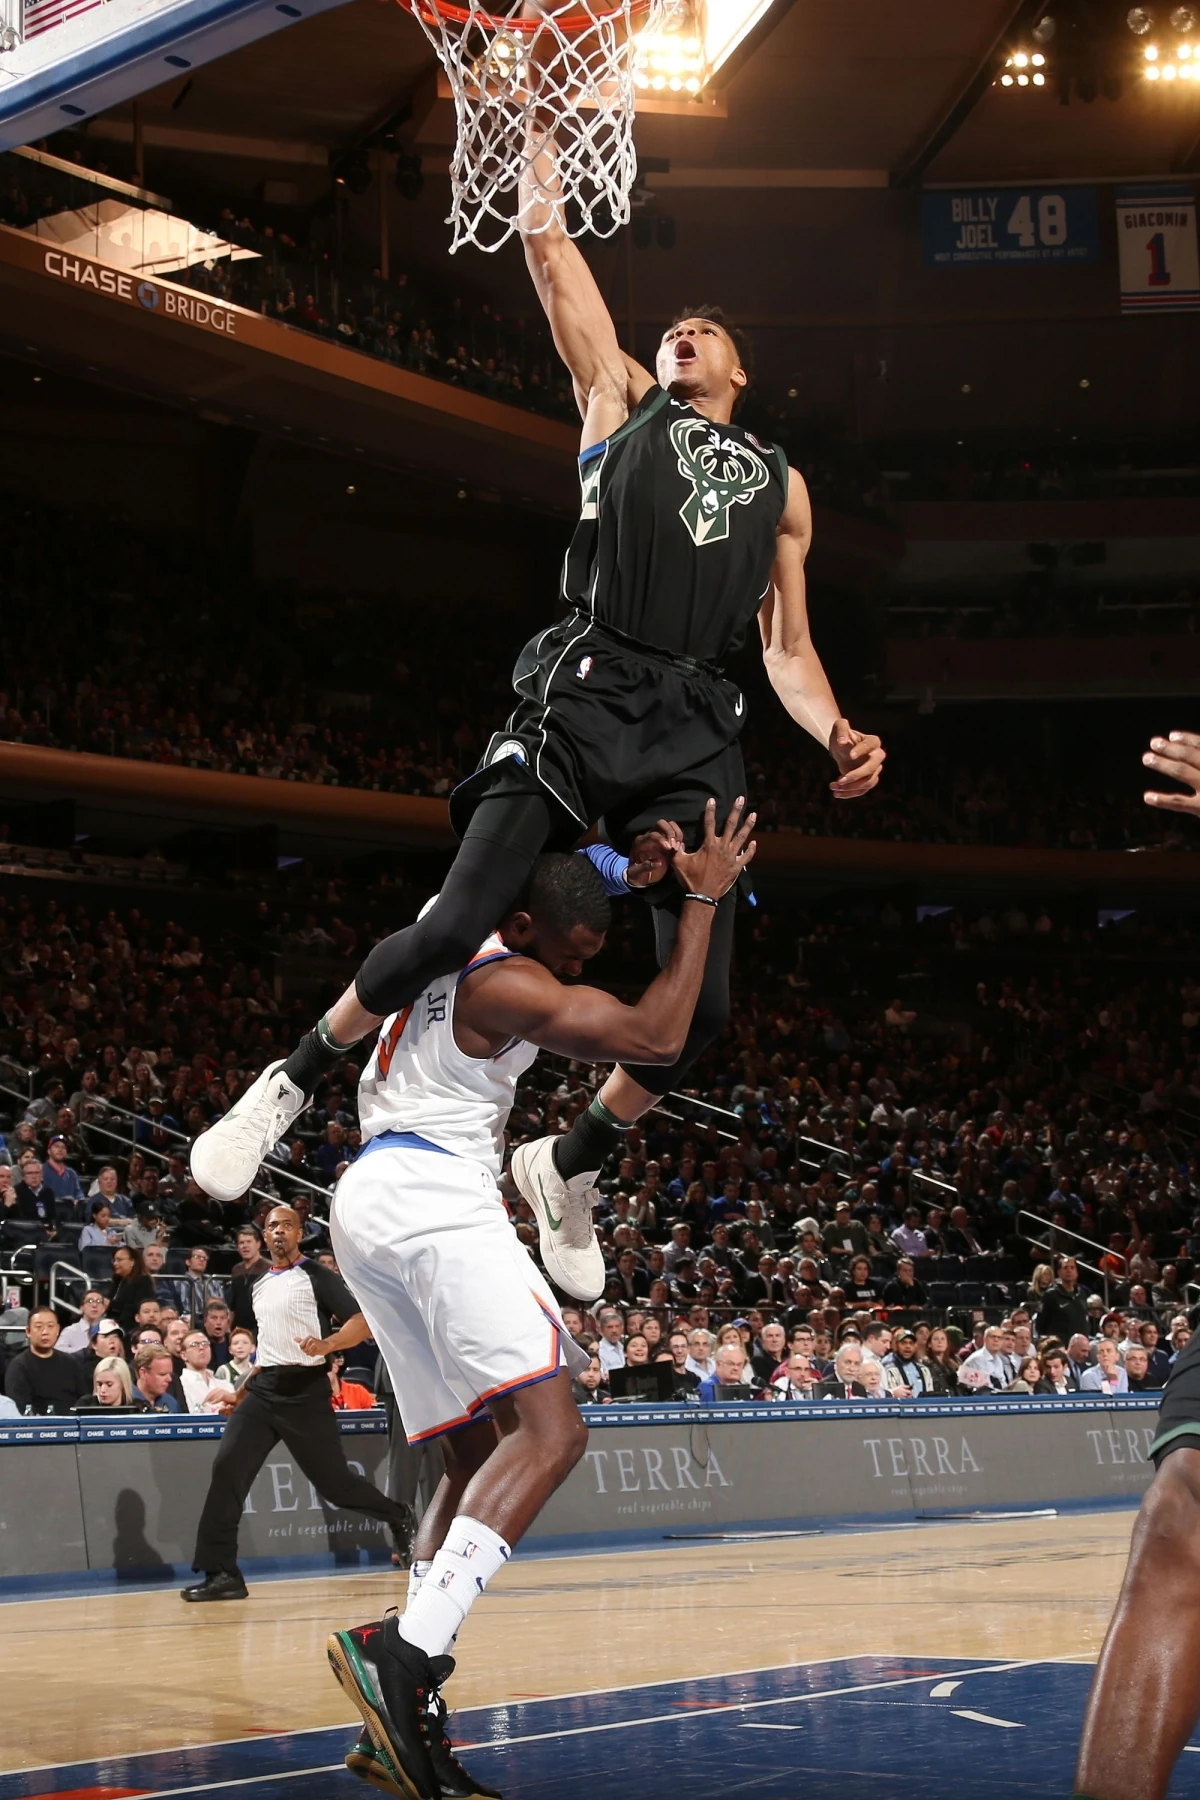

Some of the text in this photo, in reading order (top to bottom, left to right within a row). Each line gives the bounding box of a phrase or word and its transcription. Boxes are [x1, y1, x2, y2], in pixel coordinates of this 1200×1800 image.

[952, 197, 999, 222] BILLY
[1007, 194, 1067, 247] 48
[1124, 211, 1188, 229] GIACOMIN
[956, 224, 999, 249] JOEL
[1146, 232, 1171, 287] 1
[44, 251, 236, 335] CHASE BRIDGE
[707, 428, 739, 457] 34
[427, 992, 447, 1030] JR.
[584, 1447, 730, 1494] TERRA
[863, 1436, 980, 1477] TERRA
[617, 1497, 712, 1515] real vegetable chips
[268, 1523, 293, 1538] real
[298, 1520, 353, 1539] vegetable
